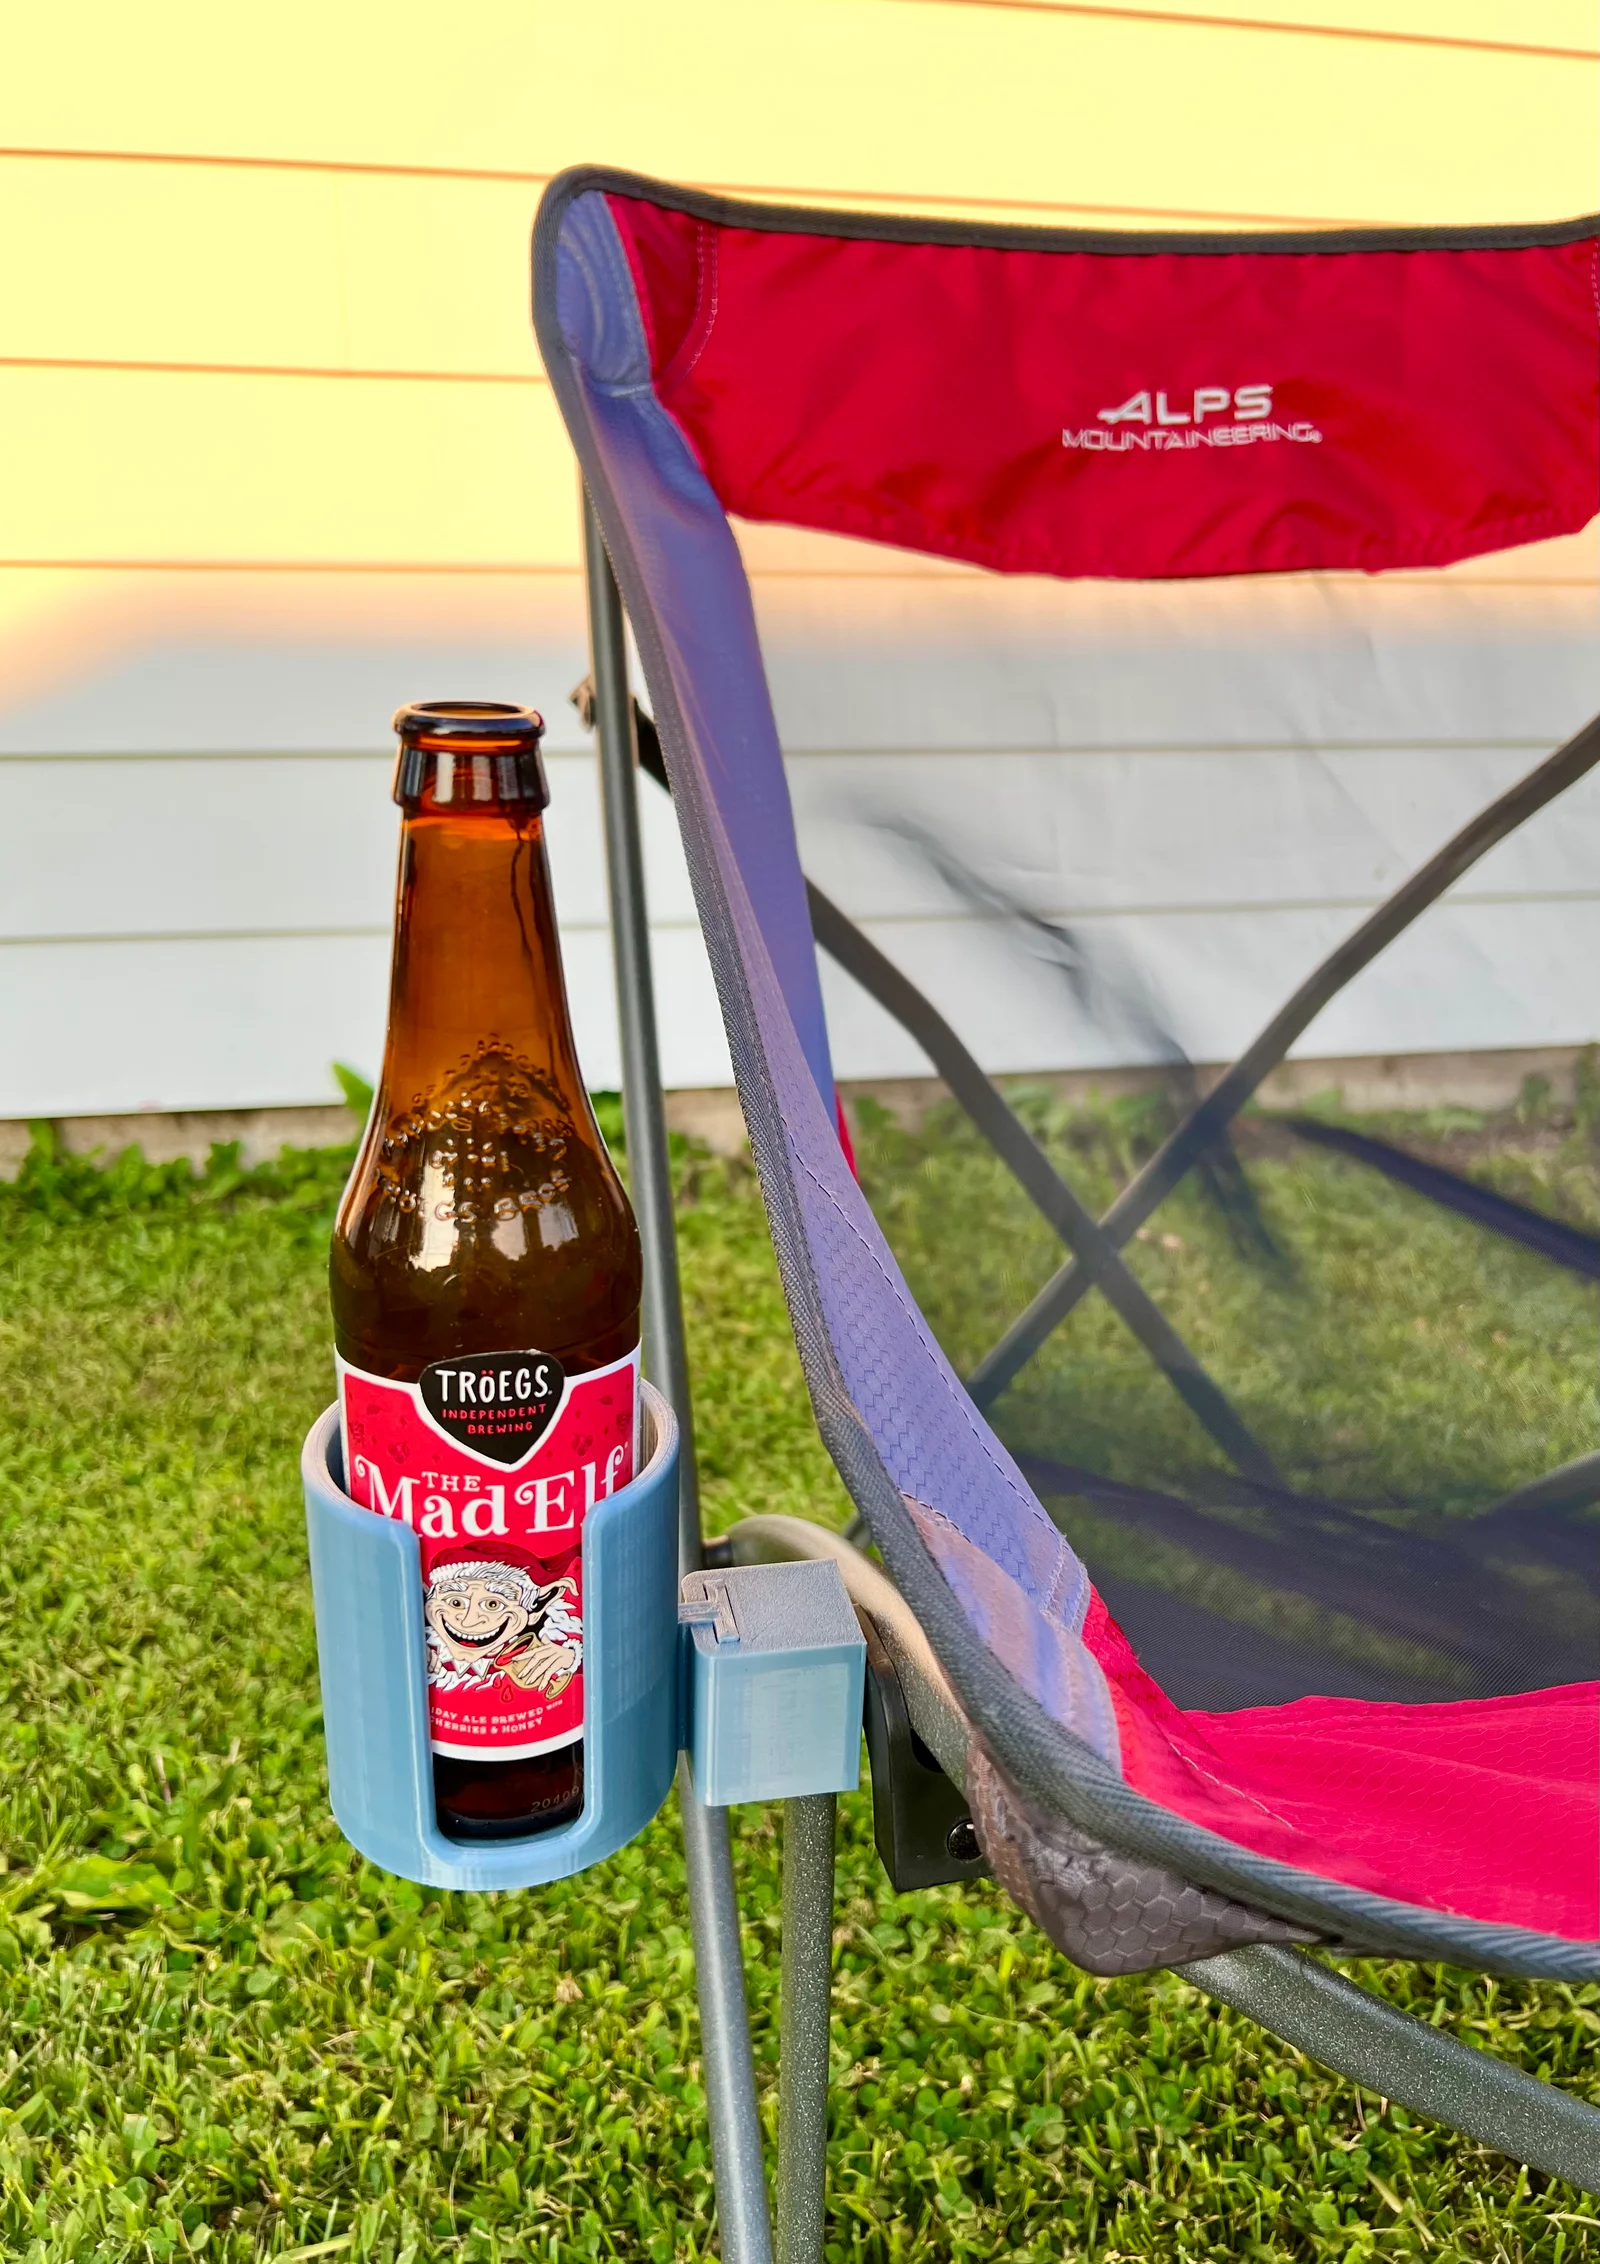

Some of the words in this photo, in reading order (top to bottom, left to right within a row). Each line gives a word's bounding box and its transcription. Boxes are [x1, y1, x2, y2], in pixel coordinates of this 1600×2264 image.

[1097, 384, 1273, 425] ALPS
[441, 1403, 547, 1420] INDEPENDENT
[467, 1421, 533, 1435] BREWING
[421, 1471, 481, 1493] THE
[354, 1453, 511, 1539] Mad
[462, 1714, 488, 1725] ALE
[491, 1707, 544, 1724] BREWED
[490, 1725, 499, 1735] &
[501, 1716, 543, 1734] HONEY
